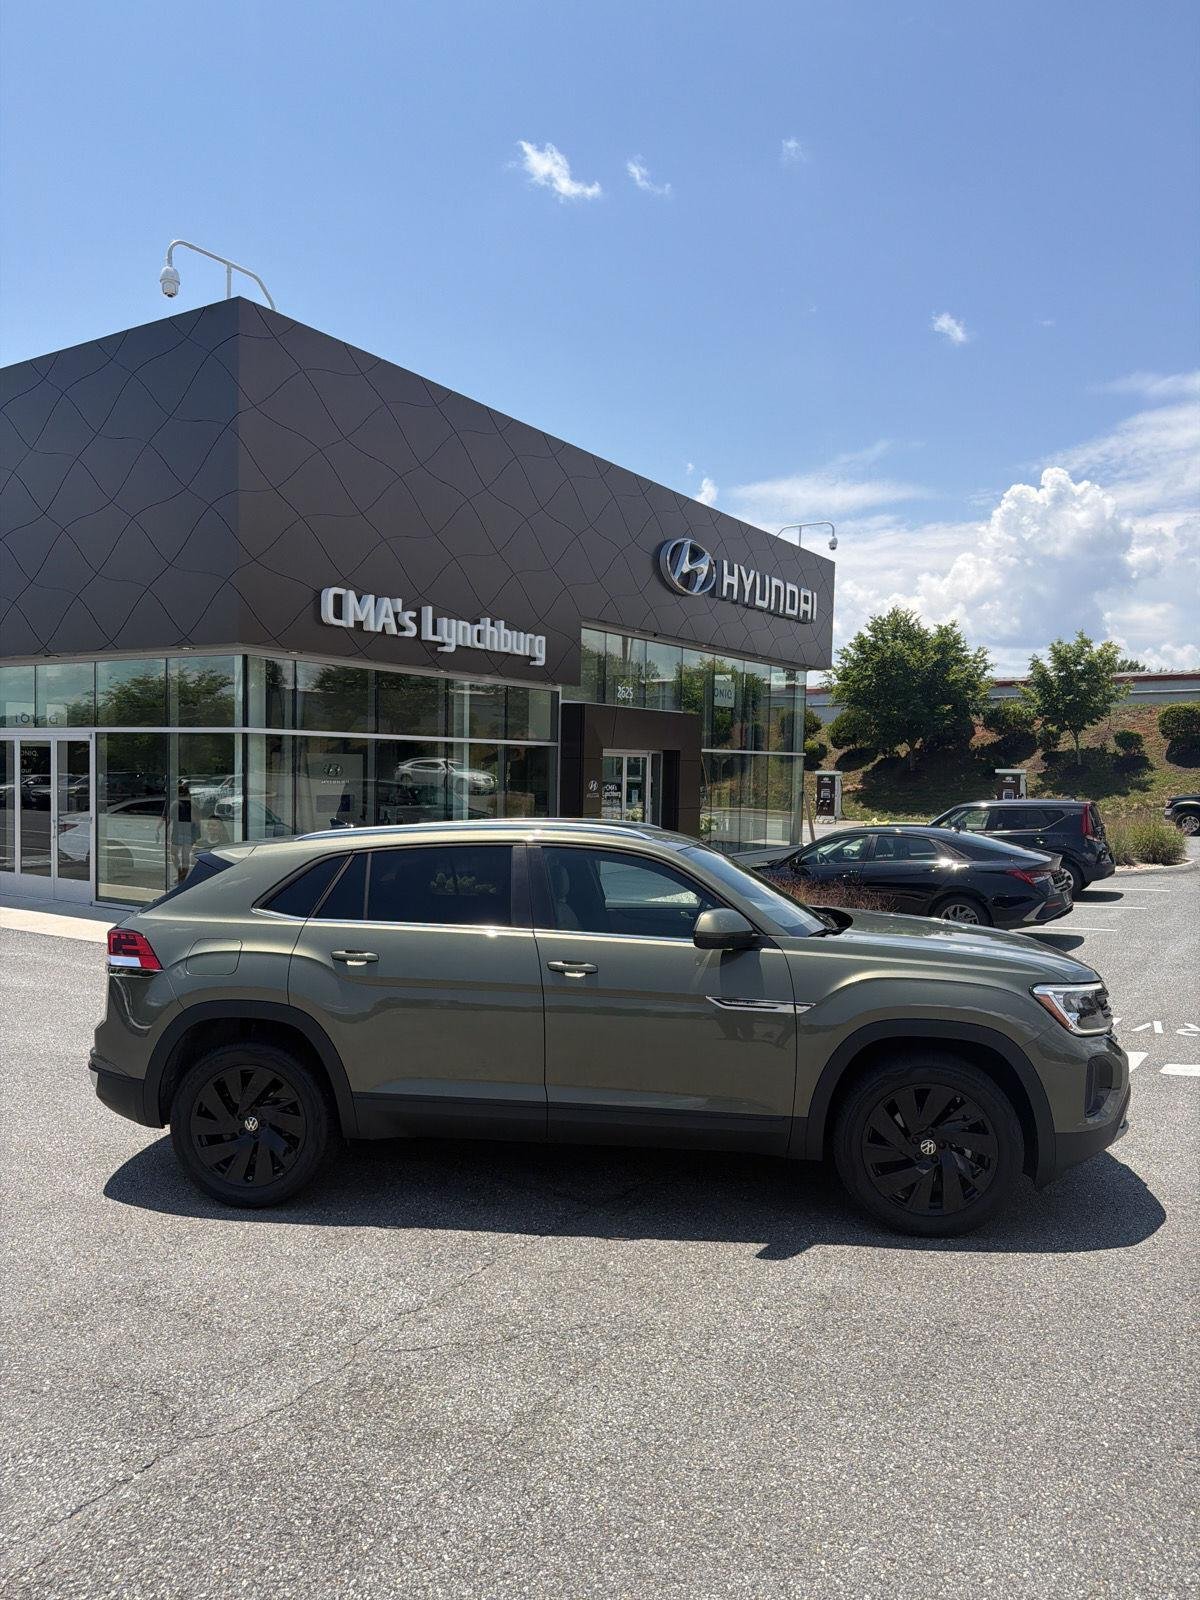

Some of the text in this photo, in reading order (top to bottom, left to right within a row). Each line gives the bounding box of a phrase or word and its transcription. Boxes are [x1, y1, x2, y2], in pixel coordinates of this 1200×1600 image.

[320, 586, 546, 666] CMA's Lynchburg
[720, 559, 817, 622] HYUNDAI
